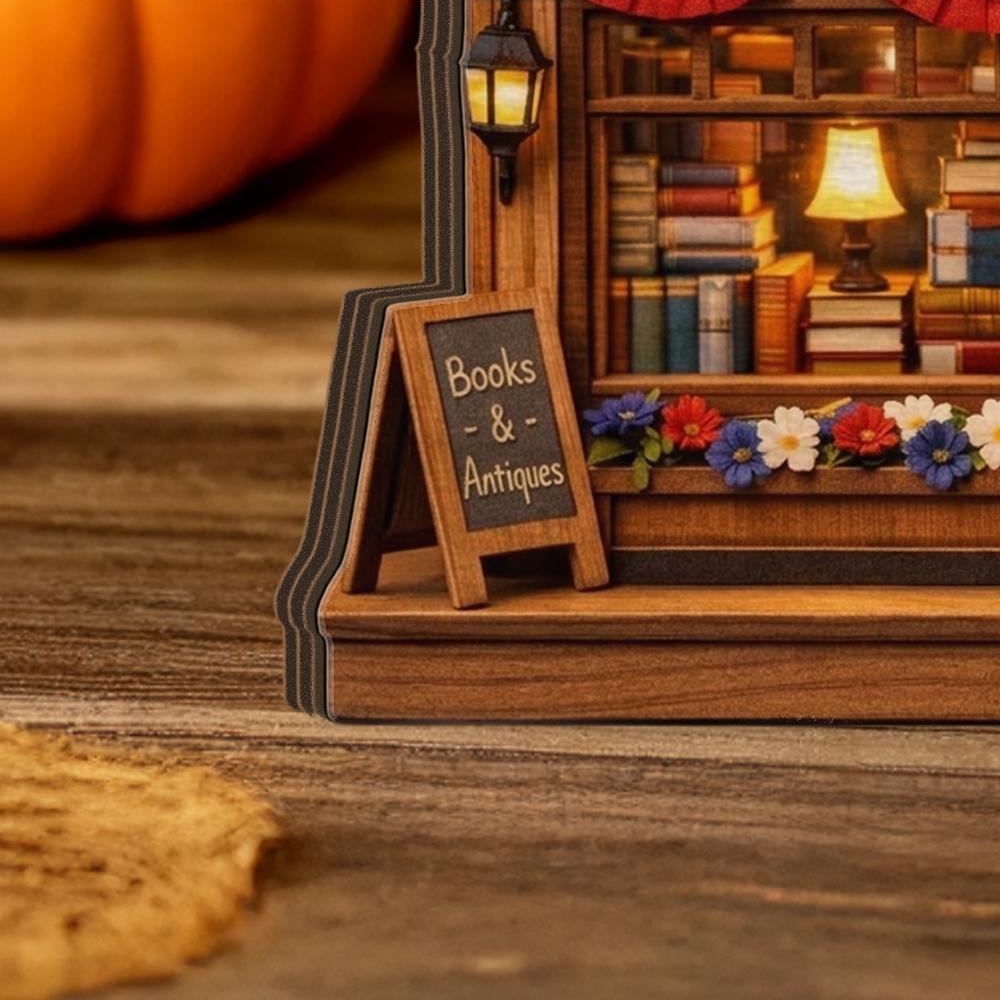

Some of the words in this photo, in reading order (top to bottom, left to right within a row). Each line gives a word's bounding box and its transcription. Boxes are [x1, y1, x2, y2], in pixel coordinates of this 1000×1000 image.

[445, 347, 537, 397] Books
[491, 404, 515, 443] &
[464, 456, 564, 504] Antiques
